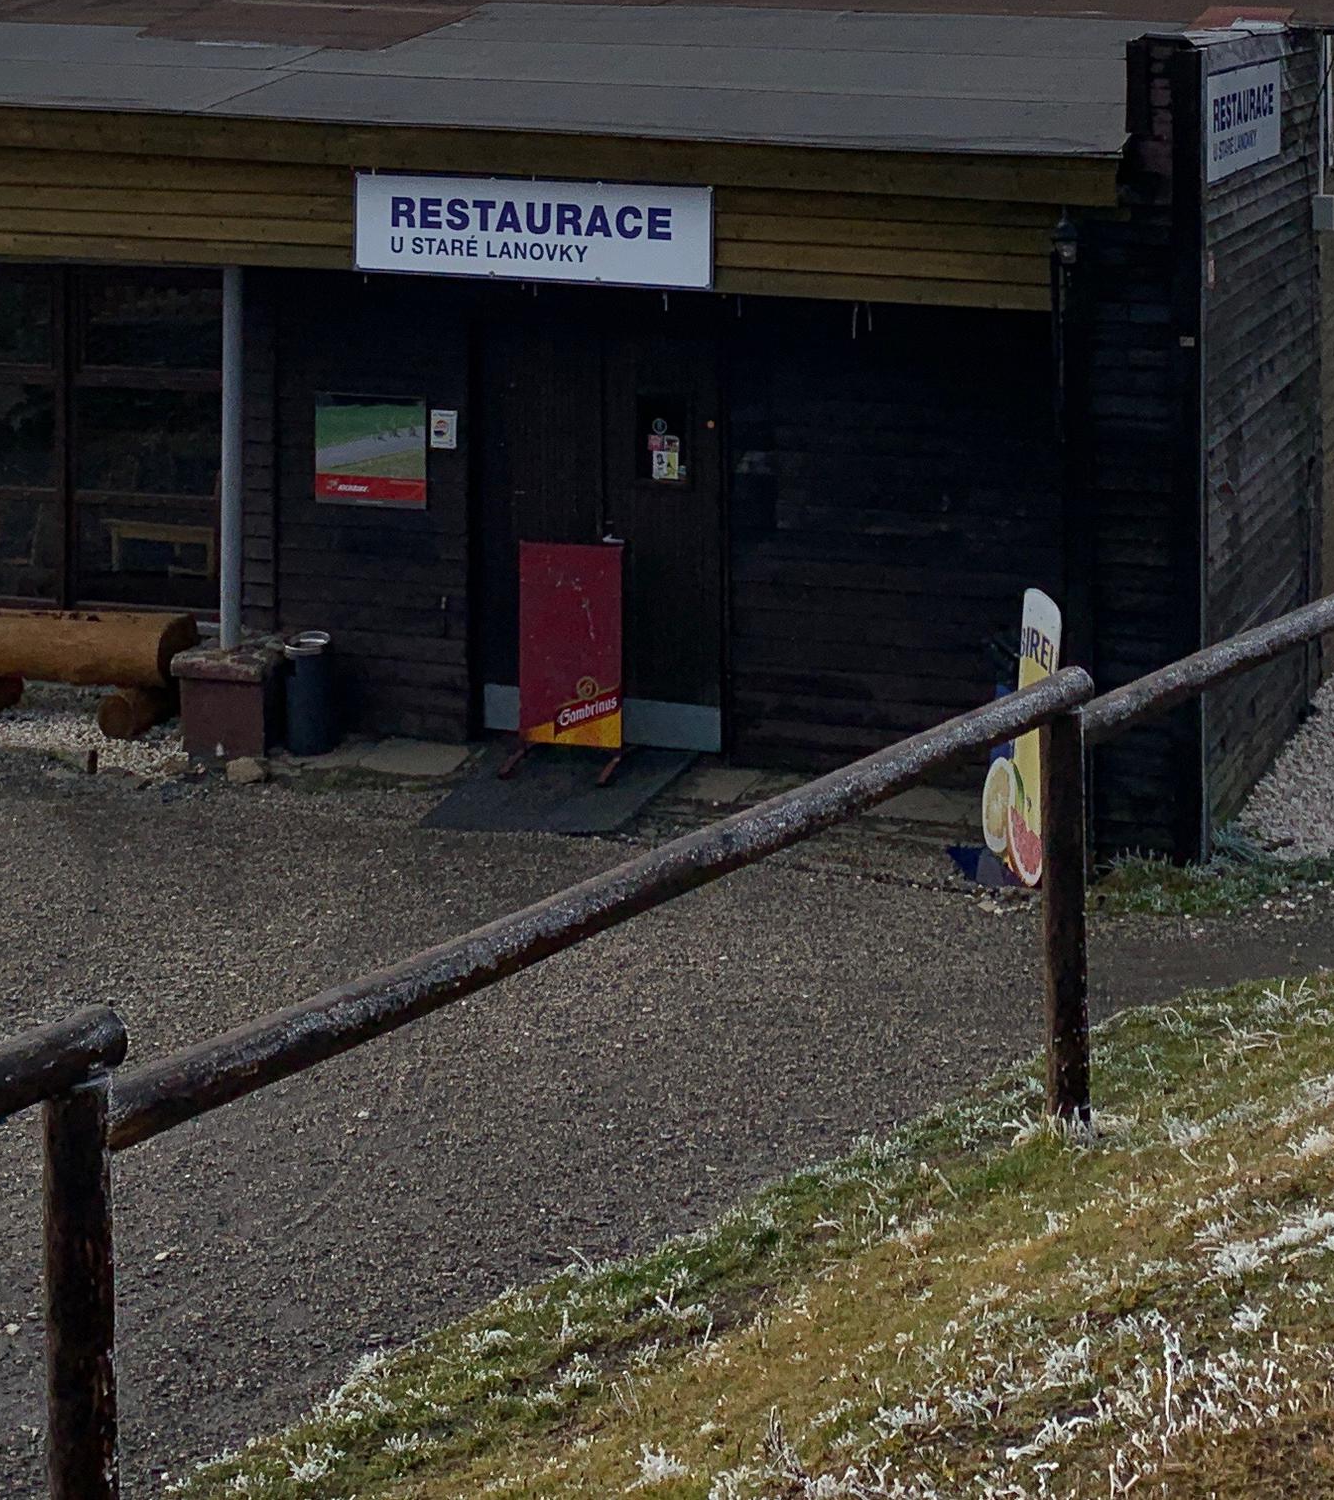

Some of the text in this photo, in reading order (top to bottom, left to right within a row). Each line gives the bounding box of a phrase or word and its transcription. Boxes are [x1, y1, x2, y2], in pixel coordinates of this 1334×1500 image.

[1213, 83, 1274, 133] RESTAURACE
[390, 196, 673, 241] RESTAURACE
[390, 234, 589, 263] U STARÉ LANOVKY
[556, 696, 619, 727] Gambrinus
